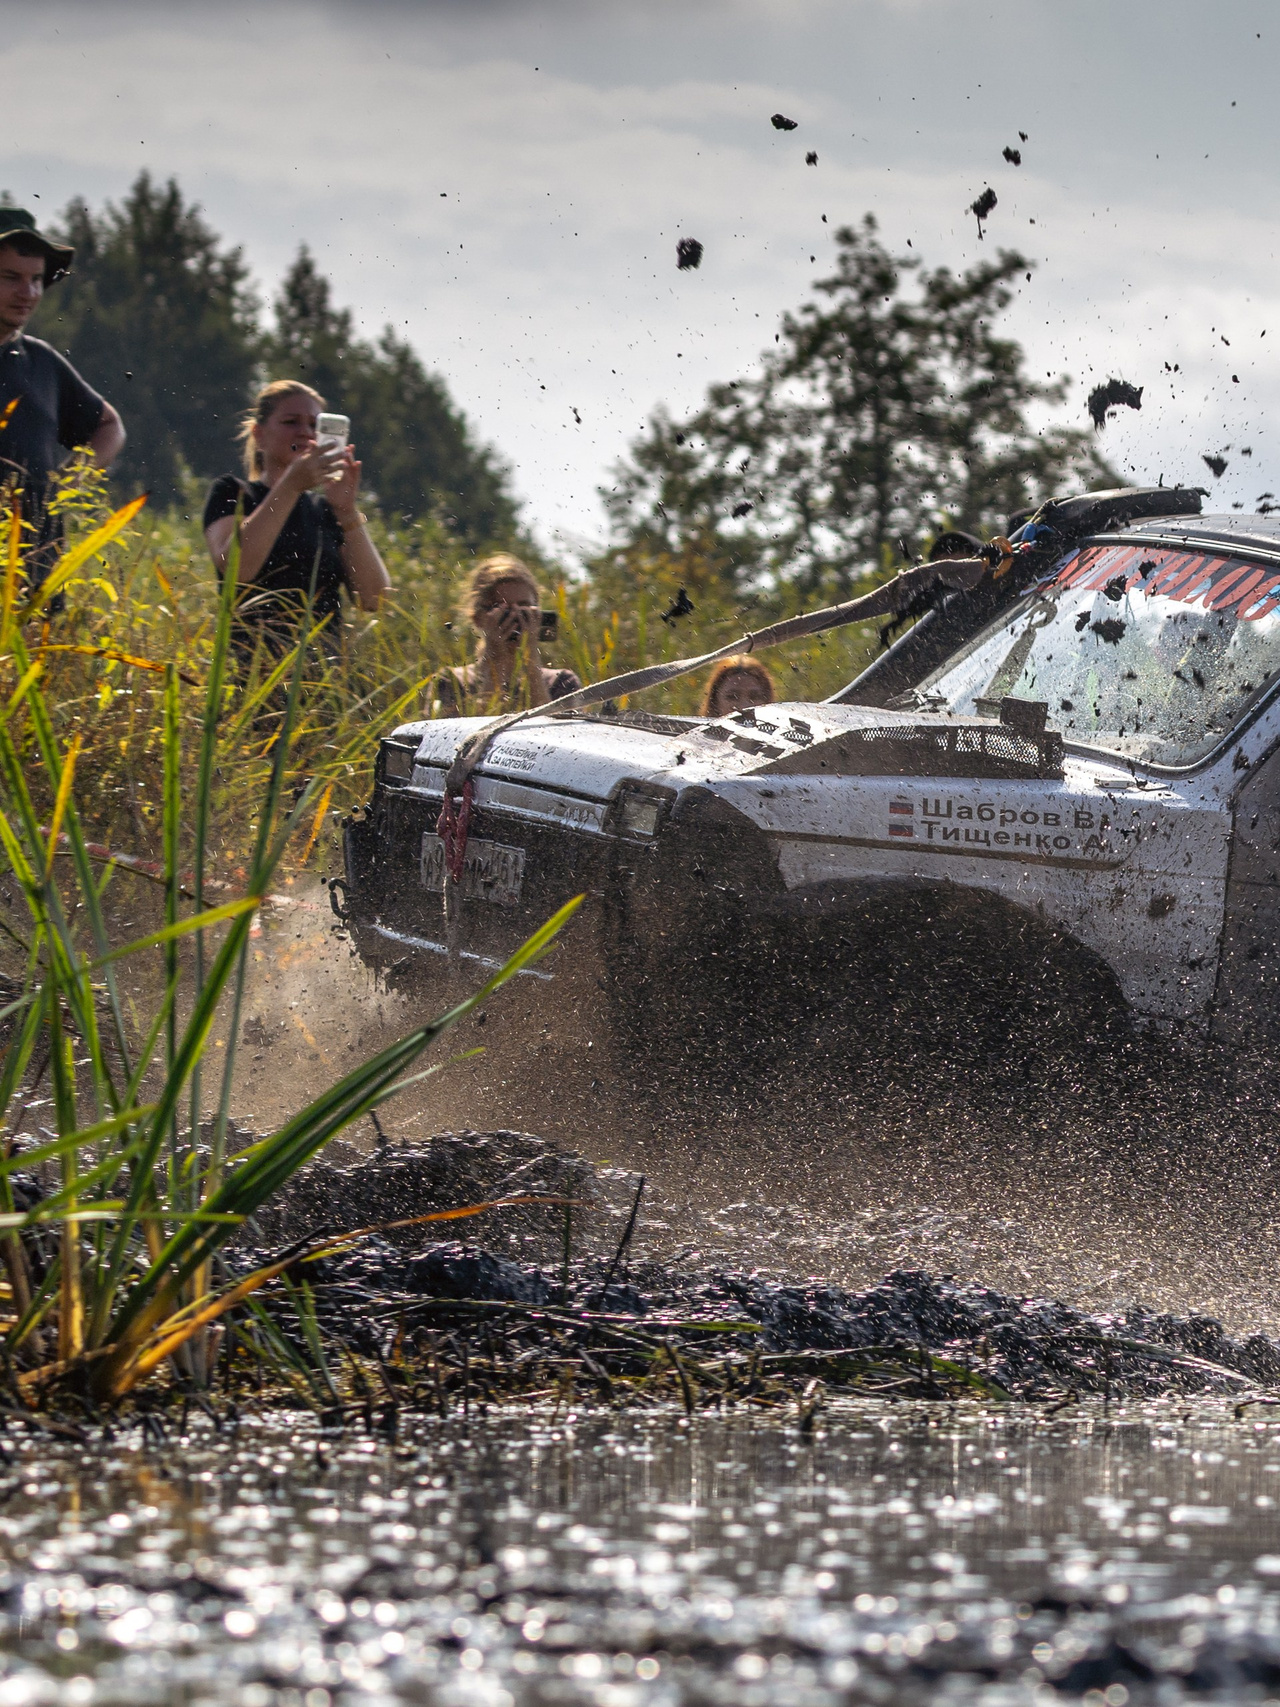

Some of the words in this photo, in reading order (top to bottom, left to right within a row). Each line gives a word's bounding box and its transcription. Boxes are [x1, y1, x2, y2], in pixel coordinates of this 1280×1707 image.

[491, 756, 500, 765] ЗА
[500, 758, 536, 771] КОПЕЙКИ
[498, 745, 538, 760] НАКЛЕЙКИ
[922, 797, 1061, 828] Шабров
[921, 820, 1071, 850] Тищенко
